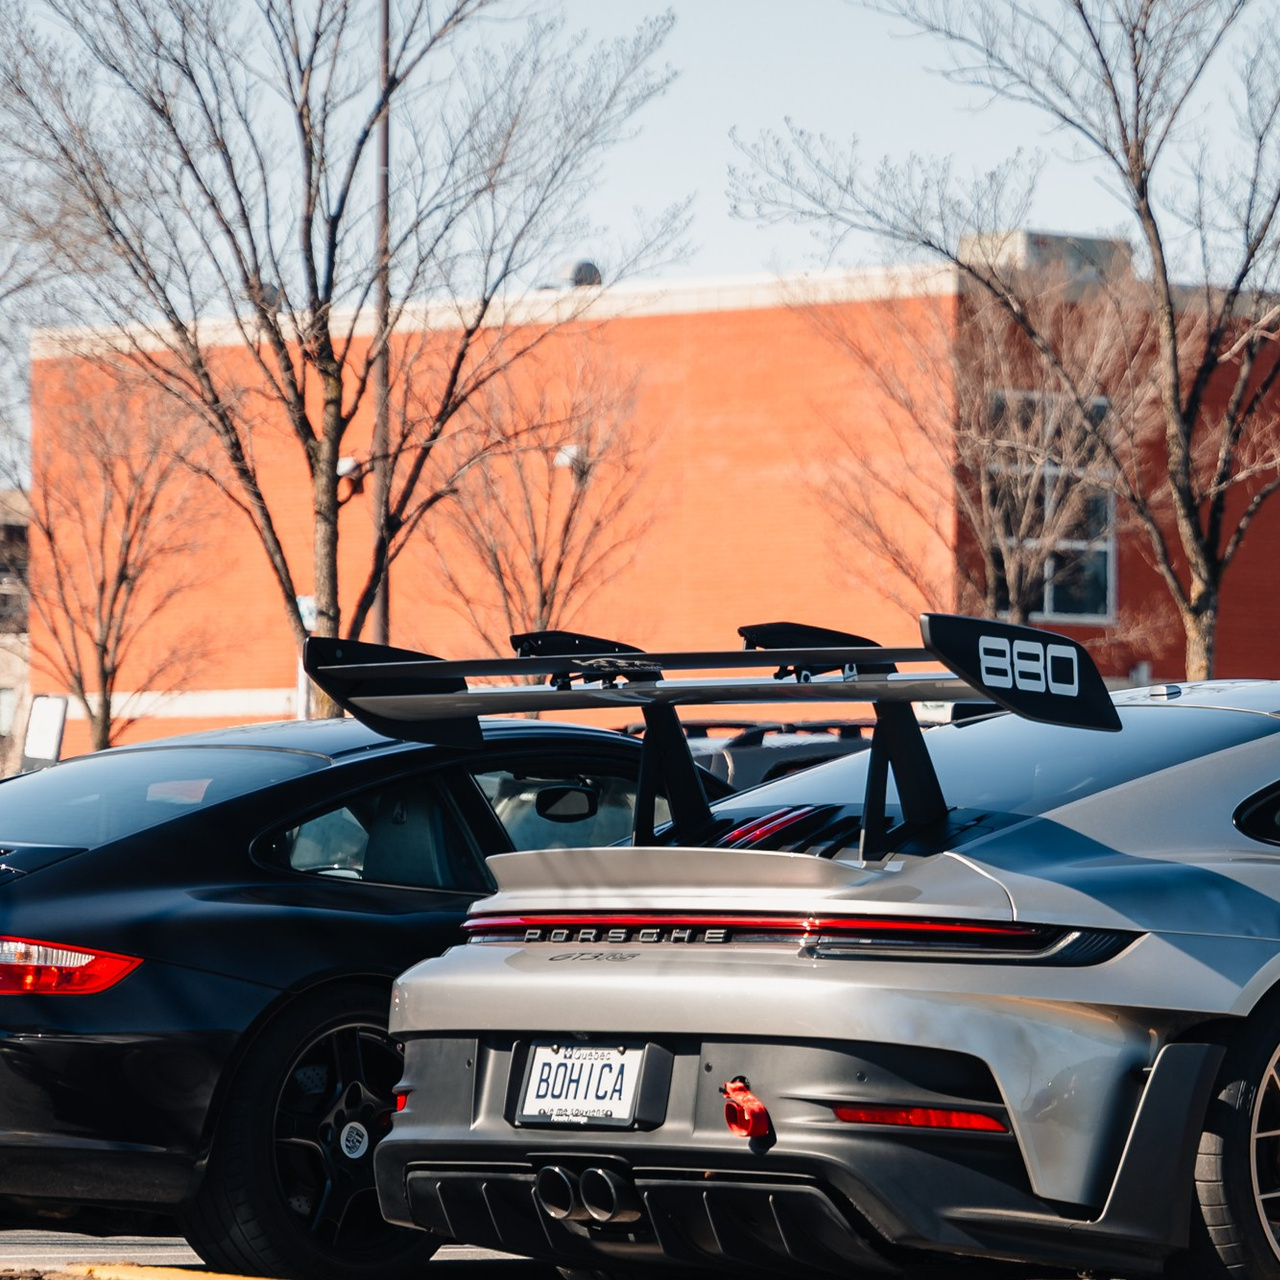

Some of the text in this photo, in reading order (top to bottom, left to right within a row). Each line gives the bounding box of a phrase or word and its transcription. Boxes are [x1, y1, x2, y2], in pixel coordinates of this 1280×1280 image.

[979, 635, 1079, 697] 880
[524, 928, 727, 943] PORSCHE
[535, 1062, 625, 1101] BOHICA
